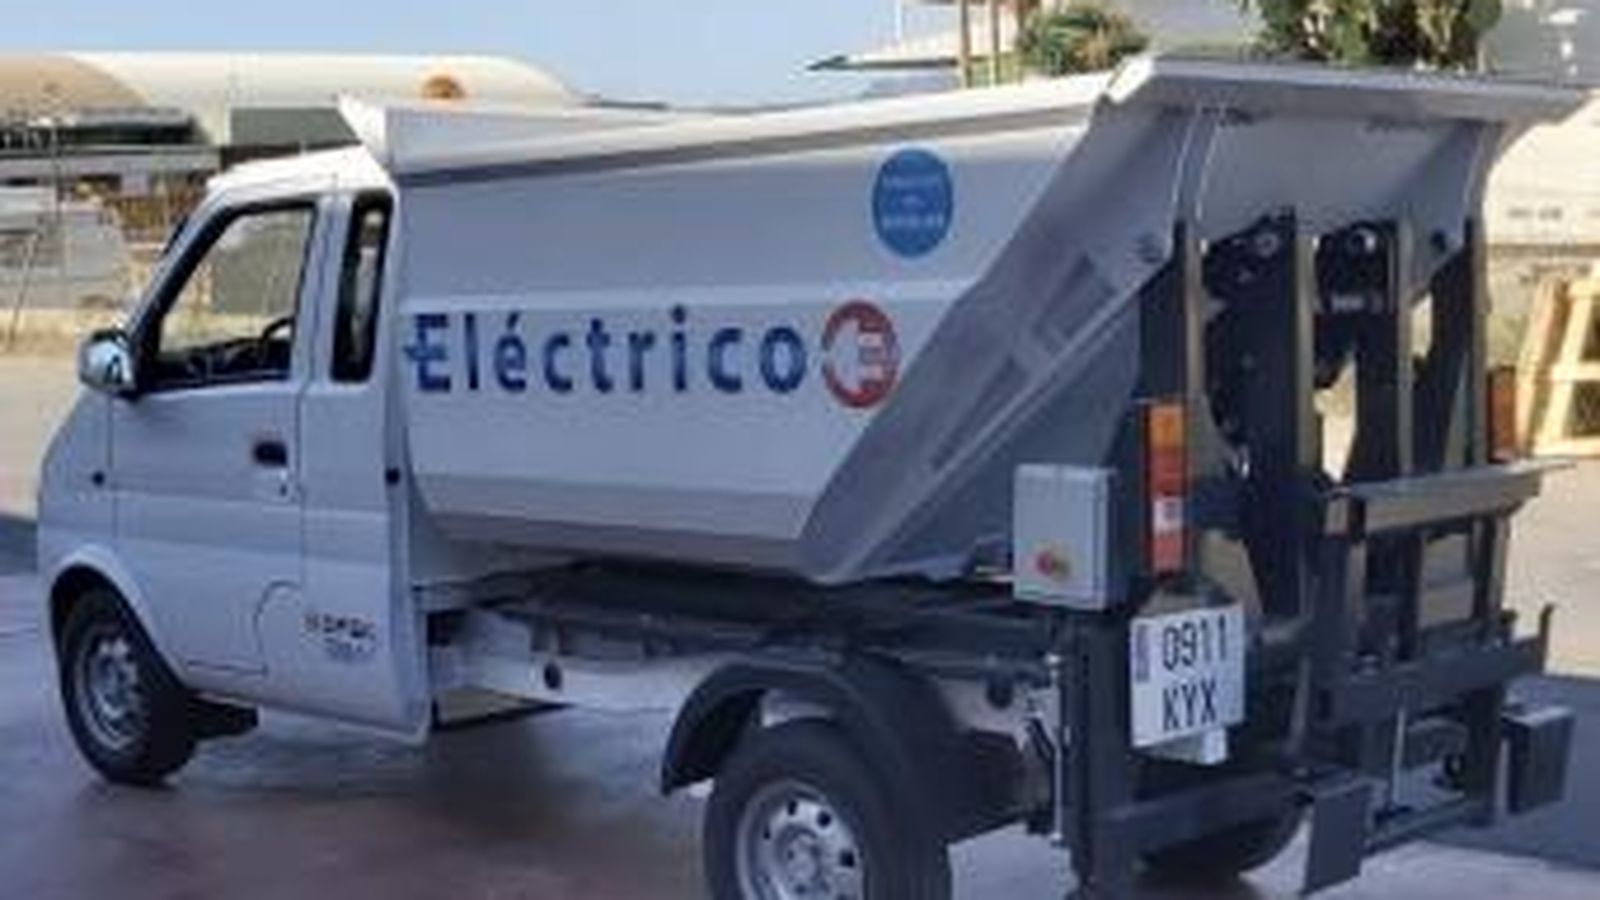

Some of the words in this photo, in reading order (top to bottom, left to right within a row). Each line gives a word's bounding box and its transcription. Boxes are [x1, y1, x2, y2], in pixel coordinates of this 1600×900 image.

[404, 305, 808, 394] Eléctrico
[1163, 614, 1228, 671] 0911
[1163, 678, 1217, 732] KYX
